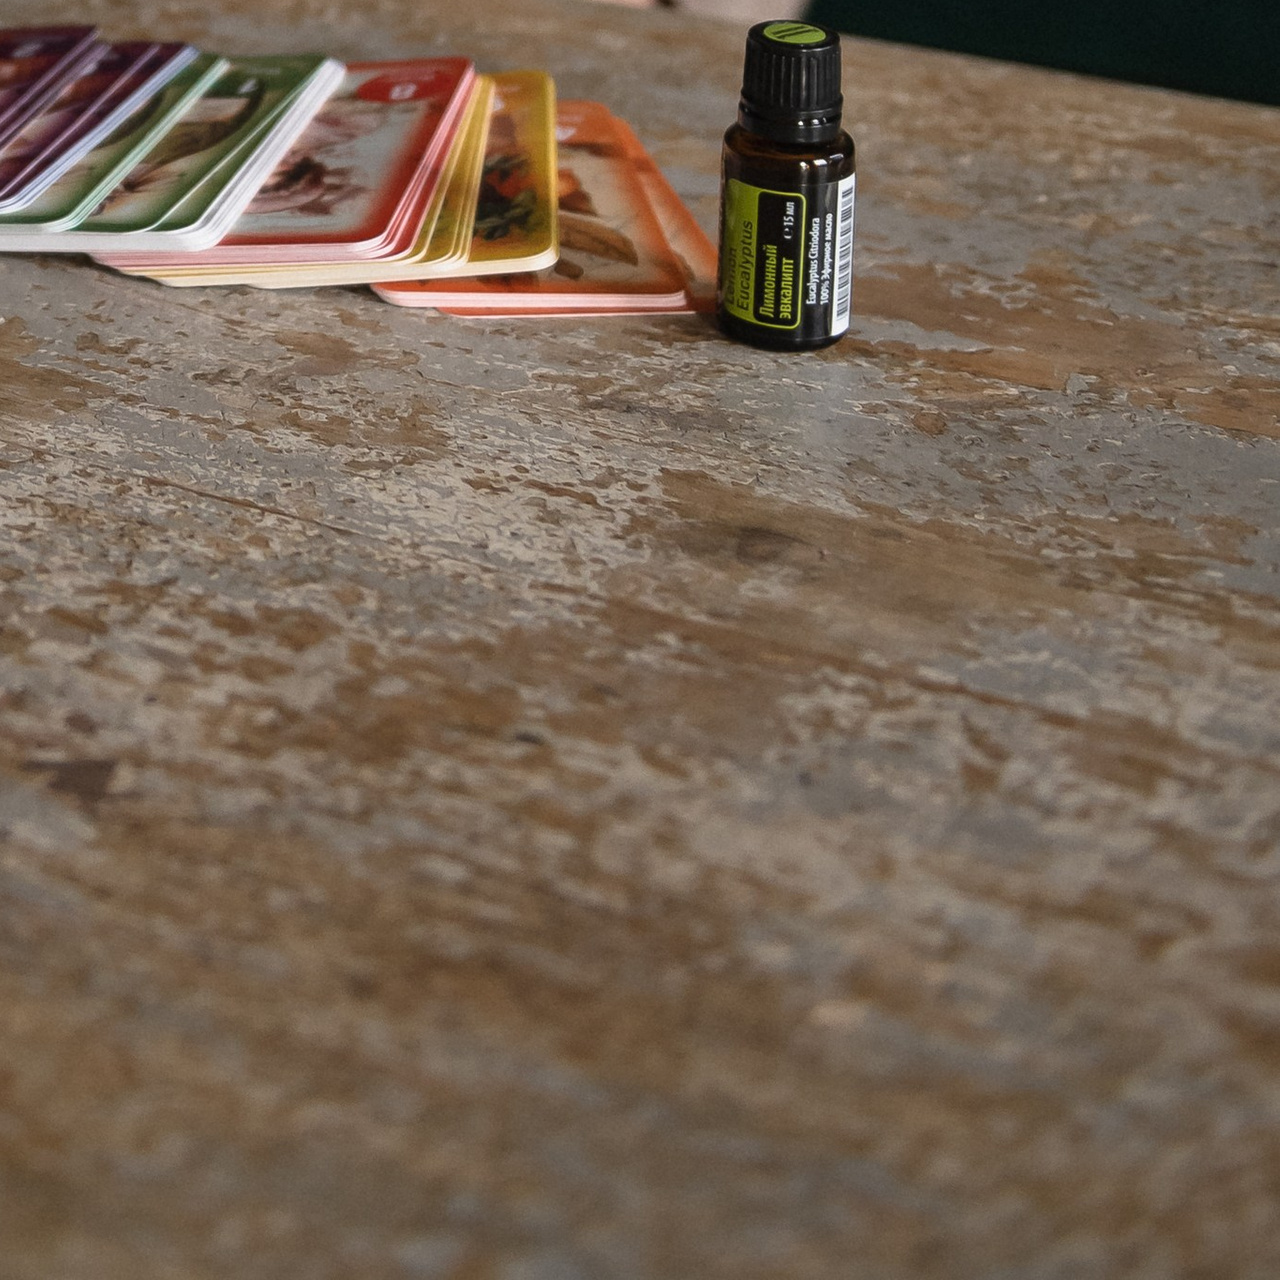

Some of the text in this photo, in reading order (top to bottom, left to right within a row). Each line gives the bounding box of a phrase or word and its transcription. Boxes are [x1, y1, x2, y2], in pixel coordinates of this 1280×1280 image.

[783, 201, 794, 226] 15 мл
[736, 219, 754, 311] Eucalyptus
[759, 244, 777, 317] Лимонный
[779, 256, 794, 318] эвкалипт
[806, 217, 821, 304] Eucalyptus Citriodora
[819, 212, 834, 304] 100% Эфирное масло
